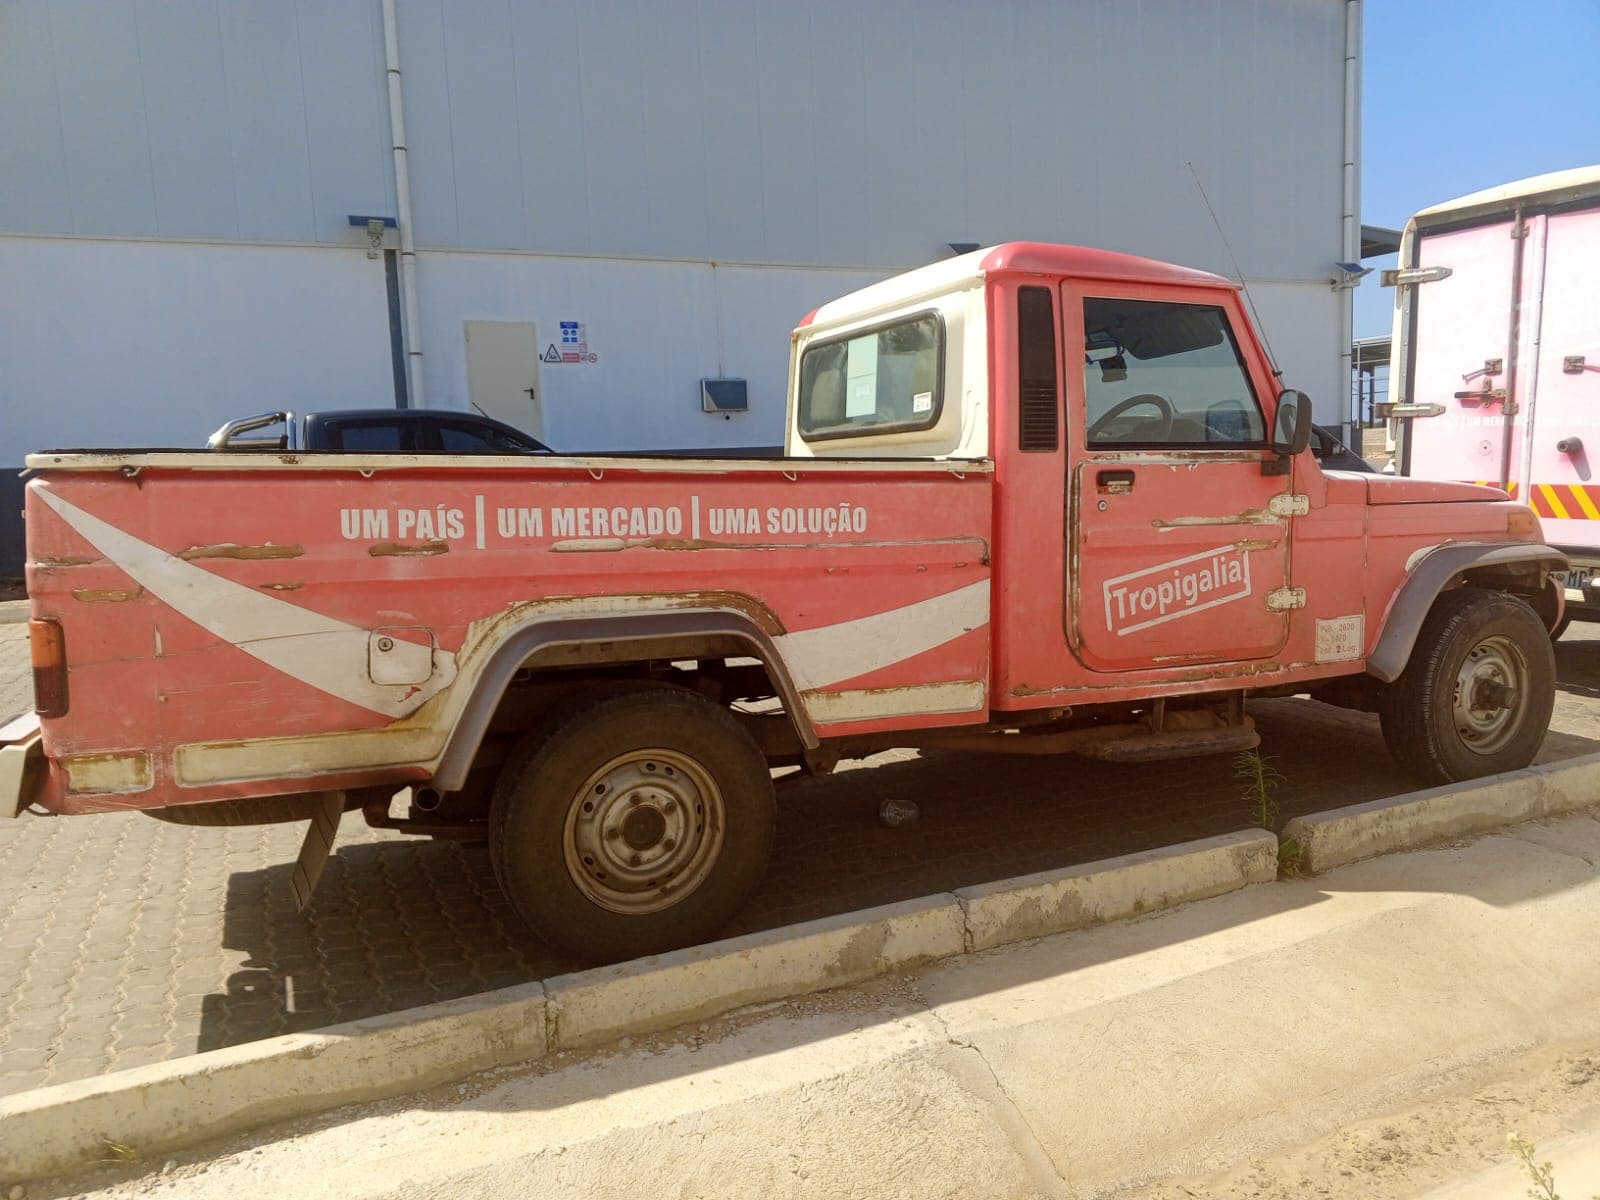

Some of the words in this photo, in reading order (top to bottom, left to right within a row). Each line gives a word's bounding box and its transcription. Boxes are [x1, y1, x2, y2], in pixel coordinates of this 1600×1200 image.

[340, 508, 389, 539] UM
[398, 503, 465, 539] PAÍS
[497, 507, 544, 538] UM
[551, 507, 682, 538] MERCADO
[709, 508, 761, 536] UMA
[767, 502, 868, 537] SOLUÇÃO
[1112, 556, 1242, 619] Tropigalia
